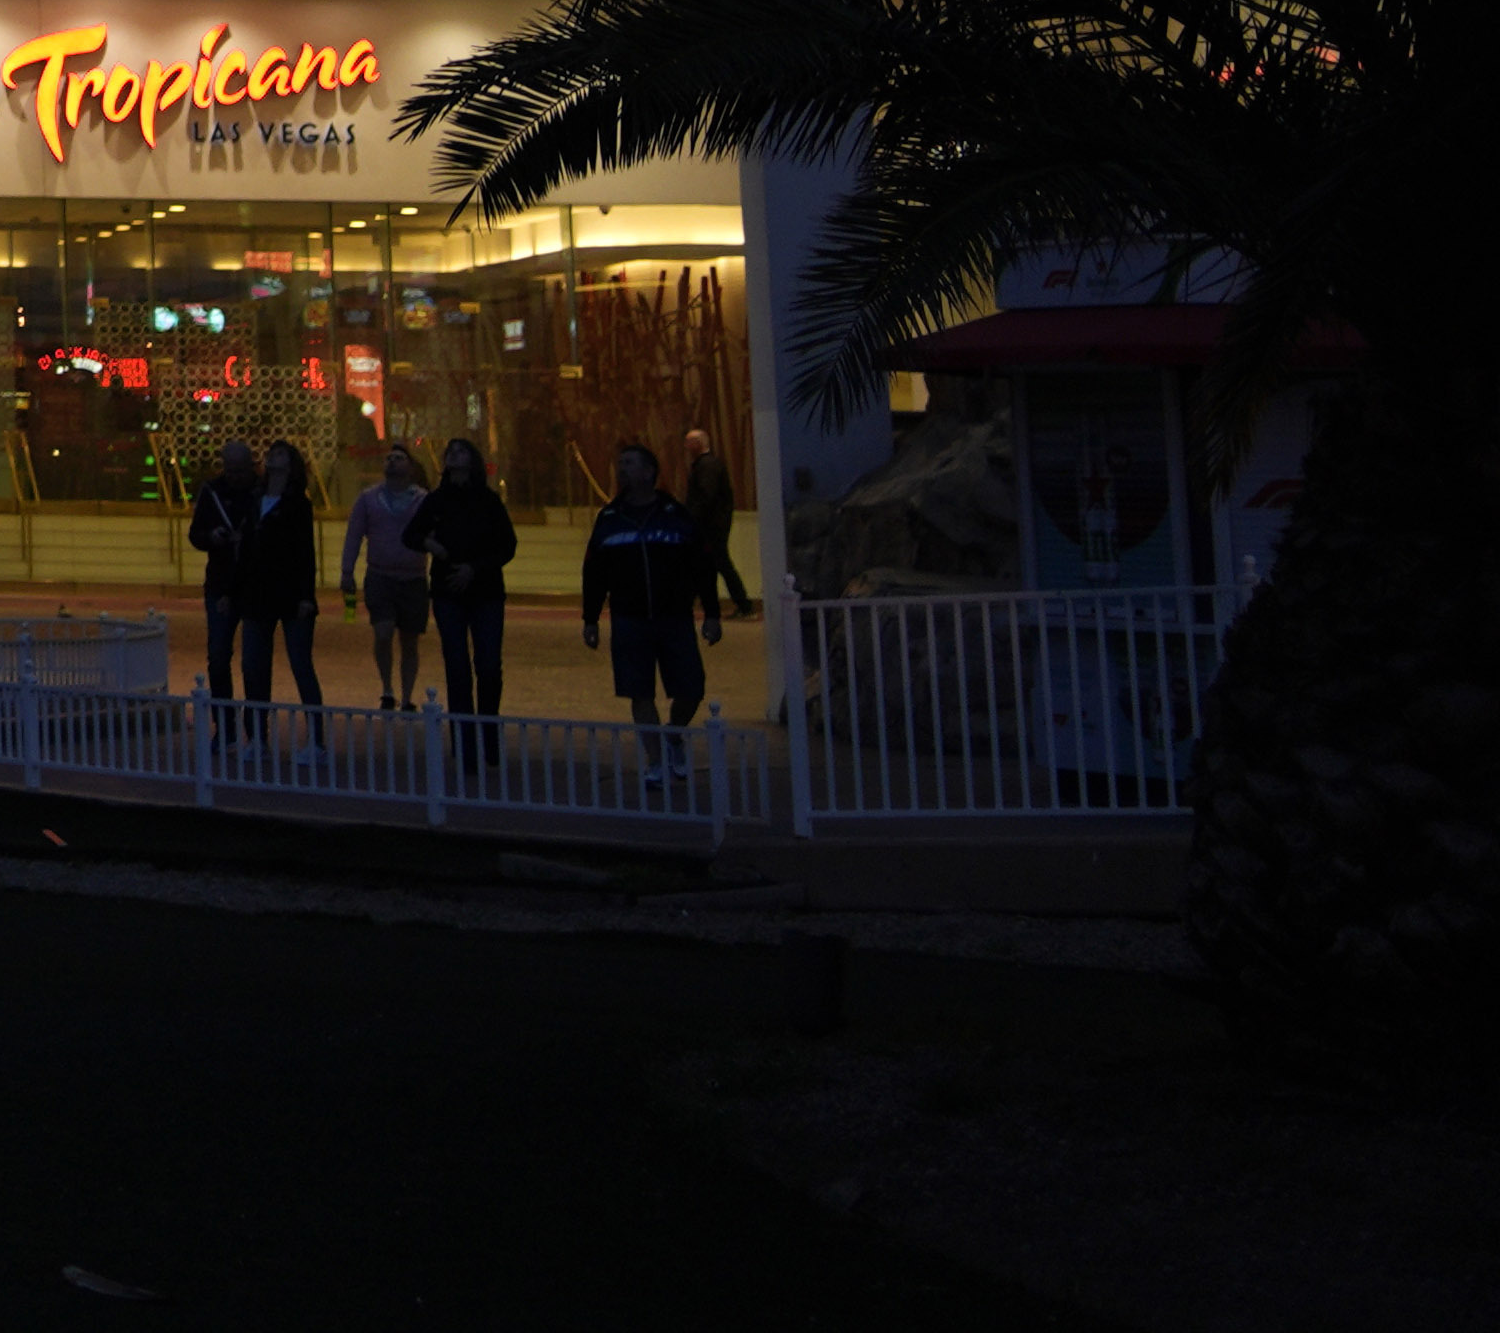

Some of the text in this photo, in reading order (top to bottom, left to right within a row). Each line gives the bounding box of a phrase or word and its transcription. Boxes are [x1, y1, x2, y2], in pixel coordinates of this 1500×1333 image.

[1, 23, 380, 164] Tropicana
[193, 121, 357, 146] LAS VEGAS
